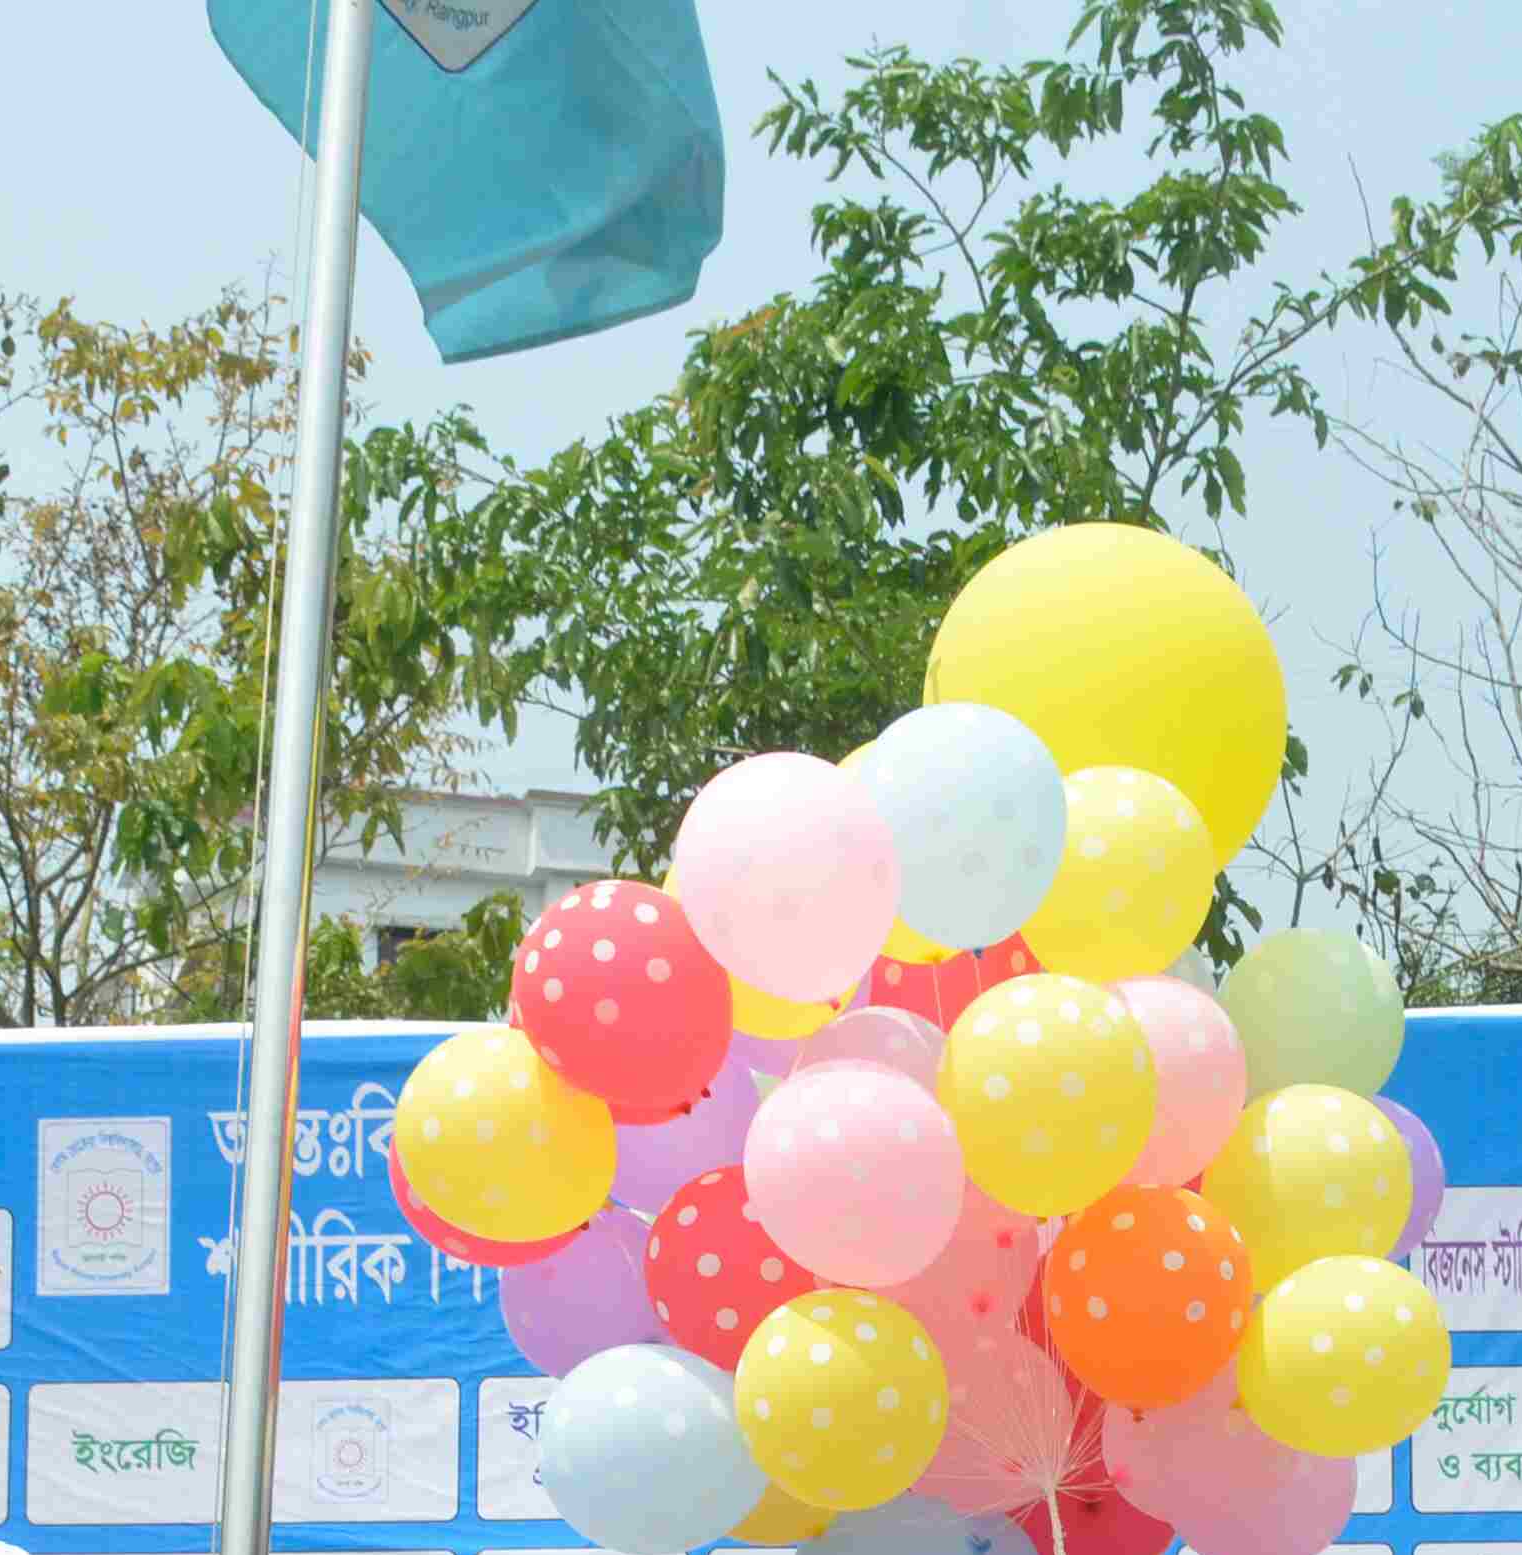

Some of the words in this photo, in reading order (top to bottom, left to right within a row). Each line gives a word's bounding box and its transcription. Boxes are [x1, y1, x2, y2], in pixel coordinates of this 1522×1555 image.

[1433, 1385, 1516, 1432] দুর্যোগ
[71, 1428, 200, 1475] ইংরেজি
[1438, 1455, 1461, 1479] ও
